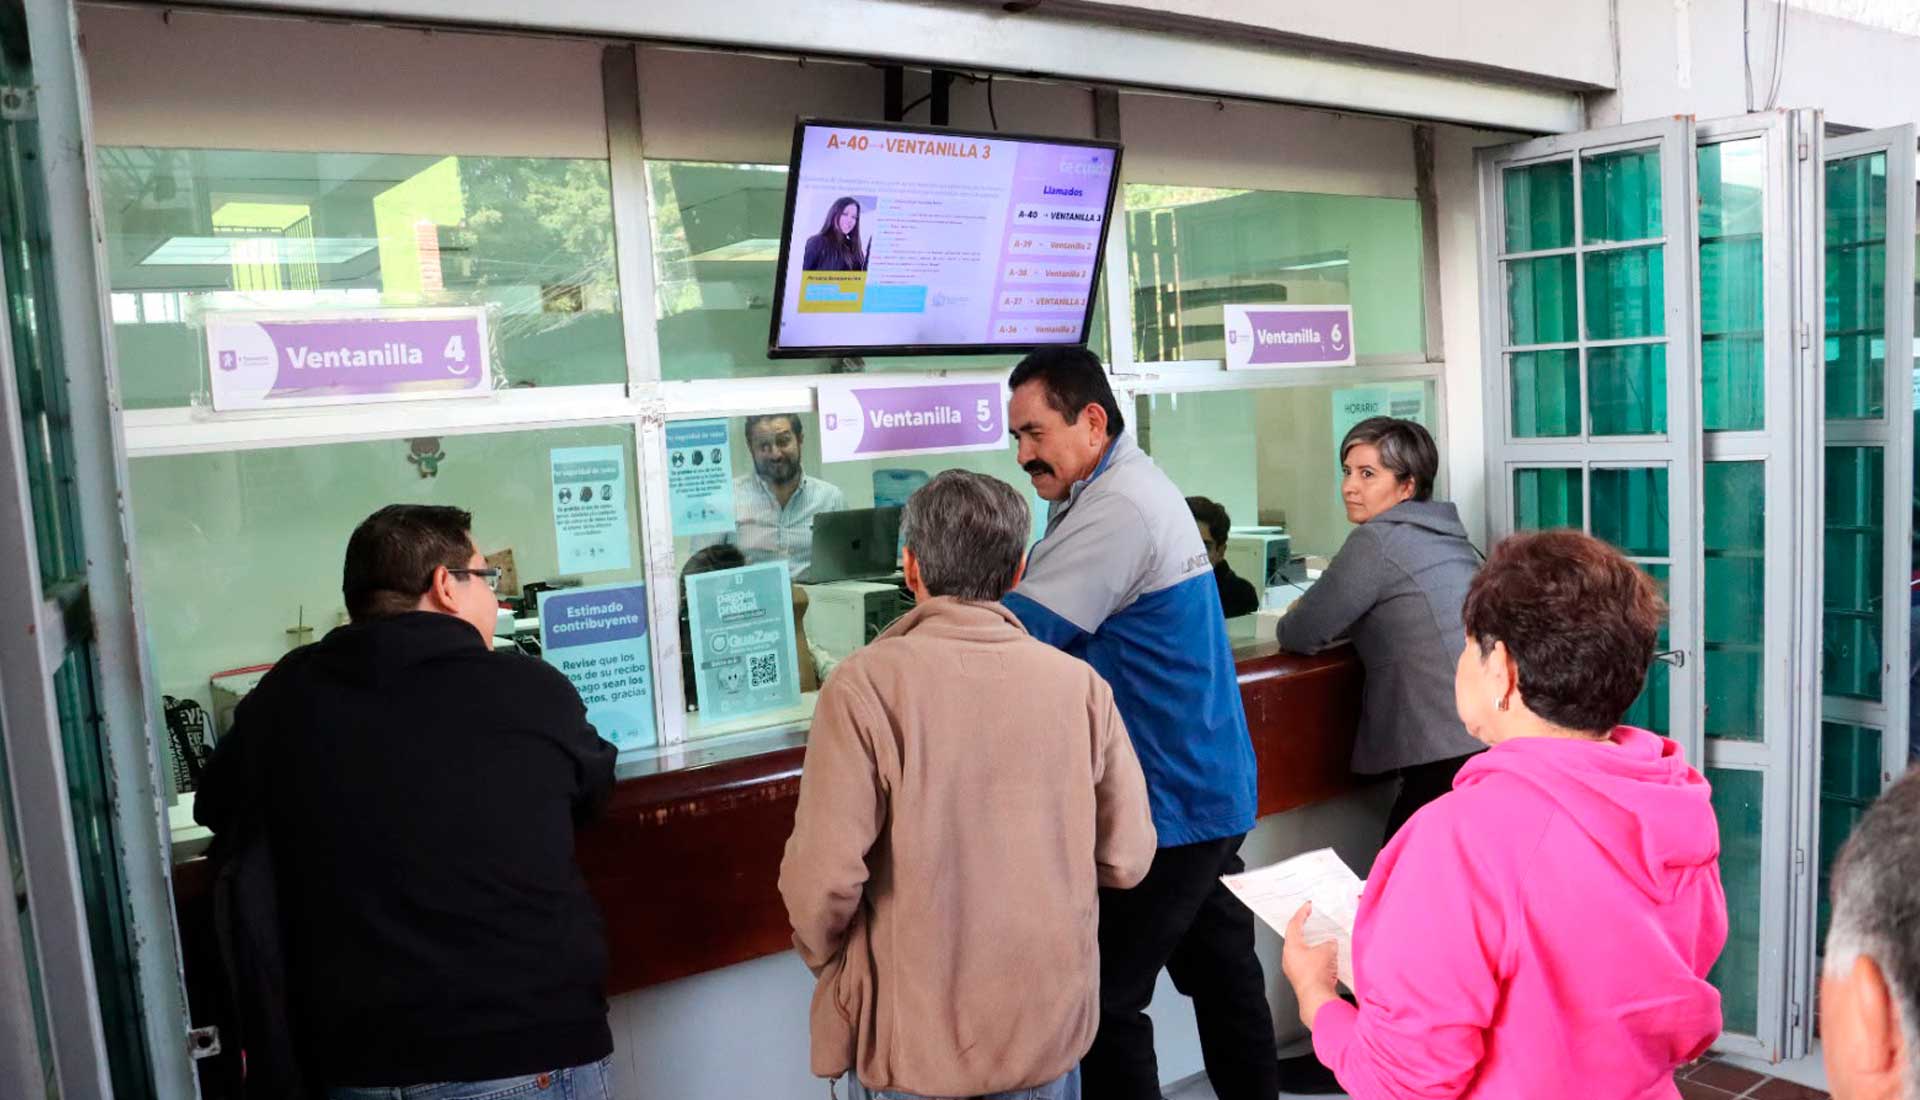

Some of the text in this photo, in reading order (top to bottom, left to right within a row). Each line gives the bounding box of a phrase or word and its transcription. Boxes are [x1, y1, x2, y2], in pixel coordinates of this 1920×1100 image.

[827, 134, 991, 160] A-40 VENTANILLA 3
[1043, 185, 1083, 197] Llamados
[1018, 210, 1039, 219] A-40
[1050, 211, 1095, 222] VENTANILLA
[1050, 241, 1085, 250] Ventanilla
[1045, 269, 1080, 278] Ventanilla
[1036, 297, 1081, 306] VENTANILLA
[1035, 325, 1070, 334] Ventanilla
[1257, 328, 1321, 345] Ventanilla
[1331, 323, 1342, 342] 6
[286, 343, 423, 369] Ventanilla
[444, 335, 466, 361] 4
[869, 406, 962, 429] Ventanilla
[977, 399, 991, 422] 5
[1344, 402, 1378, 414] HORARIO
[567, 602, 623, 618] Estimado
[552, 614, 639, 633] contribuyente
[563, 653, 635, 671] Revise que los
[584, 668, 598, 681] de
[600, 668, 612, 678] su
[614, 663, 646, 676] recibo
[602, 679, 627, 689] sean
[628, 675, 643, 686] los
[611, 687, 647, 703] gracias
